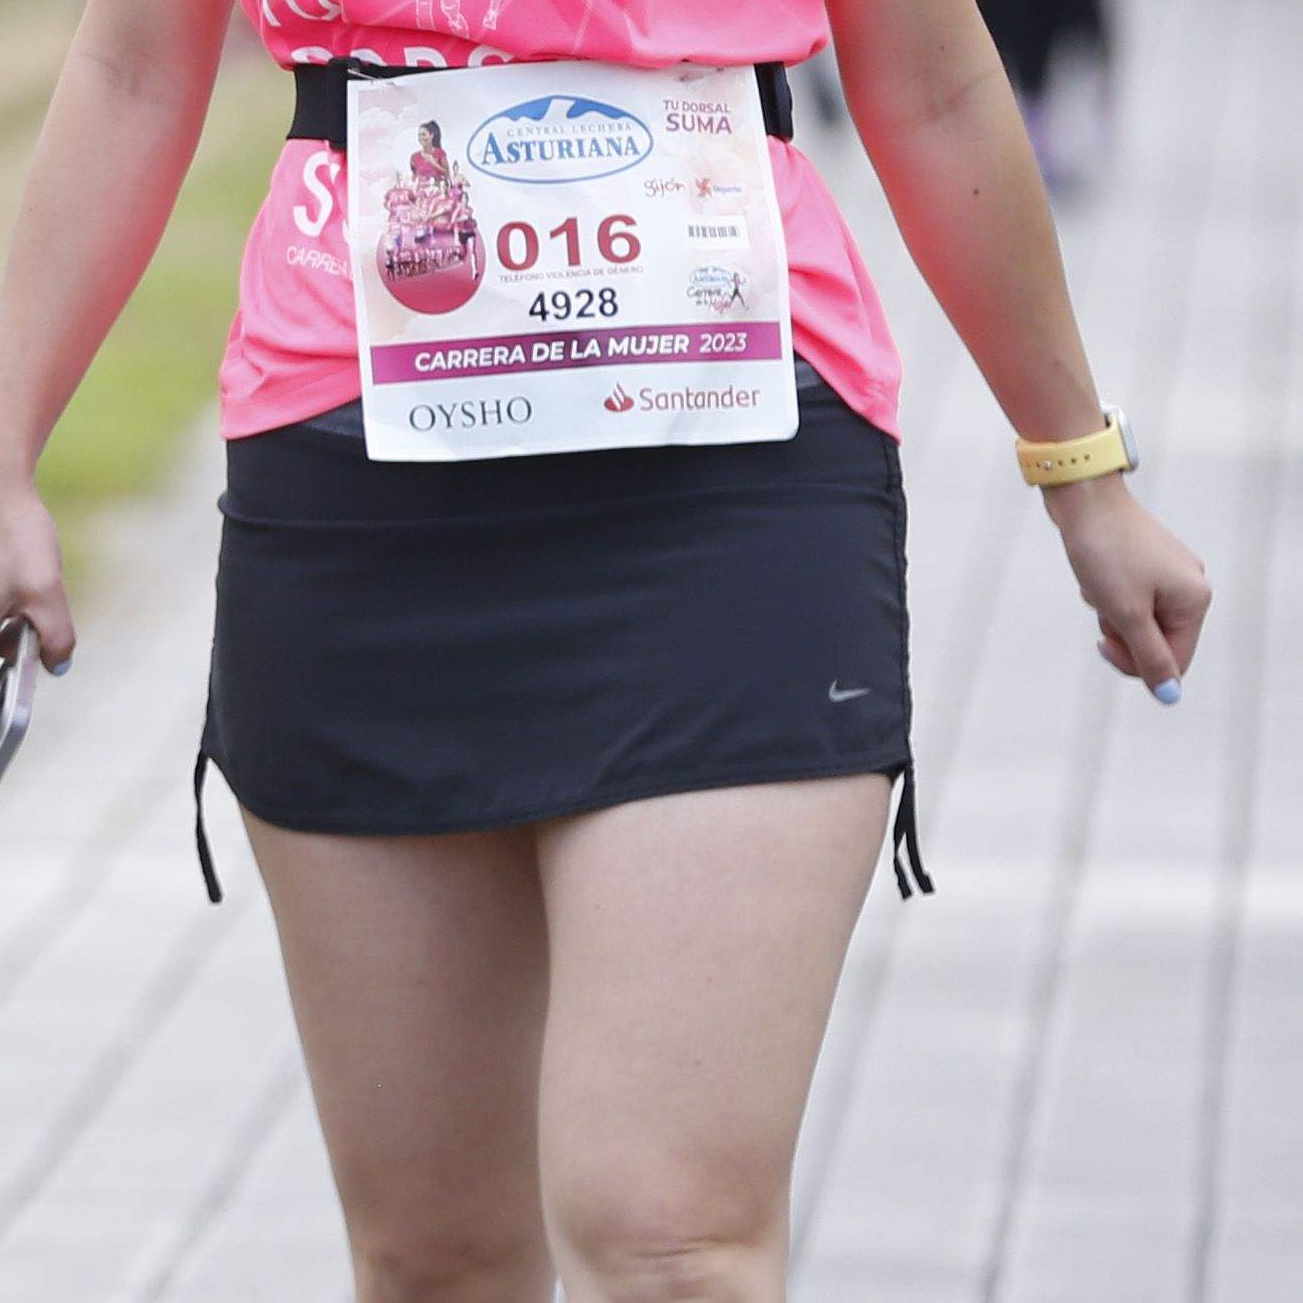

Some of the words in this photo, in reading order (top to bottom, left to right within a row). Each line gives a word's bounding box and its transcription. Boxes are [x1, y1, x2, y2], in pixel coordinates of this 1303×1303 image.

[663, 98, 679, 111] TU
[681, 100, 731, 114] DORSAL
[665, 112, 733, 135] SUMA
[481, 131, 641, 166] ASTURIANA
[496, 213, 642, 272] 016
[286, 245, 352, 279] CARRE
[528, 287, 619, 322] 4928
[414, 344, 526, 373] CARRERA
[531, 341, 565, 362] DE
[570, 339, 602, 360] LA
[608, 333, 690, 357] MUJER
[699, 331, 748, 354] 2023
[408, 396, 533, 432] OYSHO
[639, 384, 761, 412] Santander
